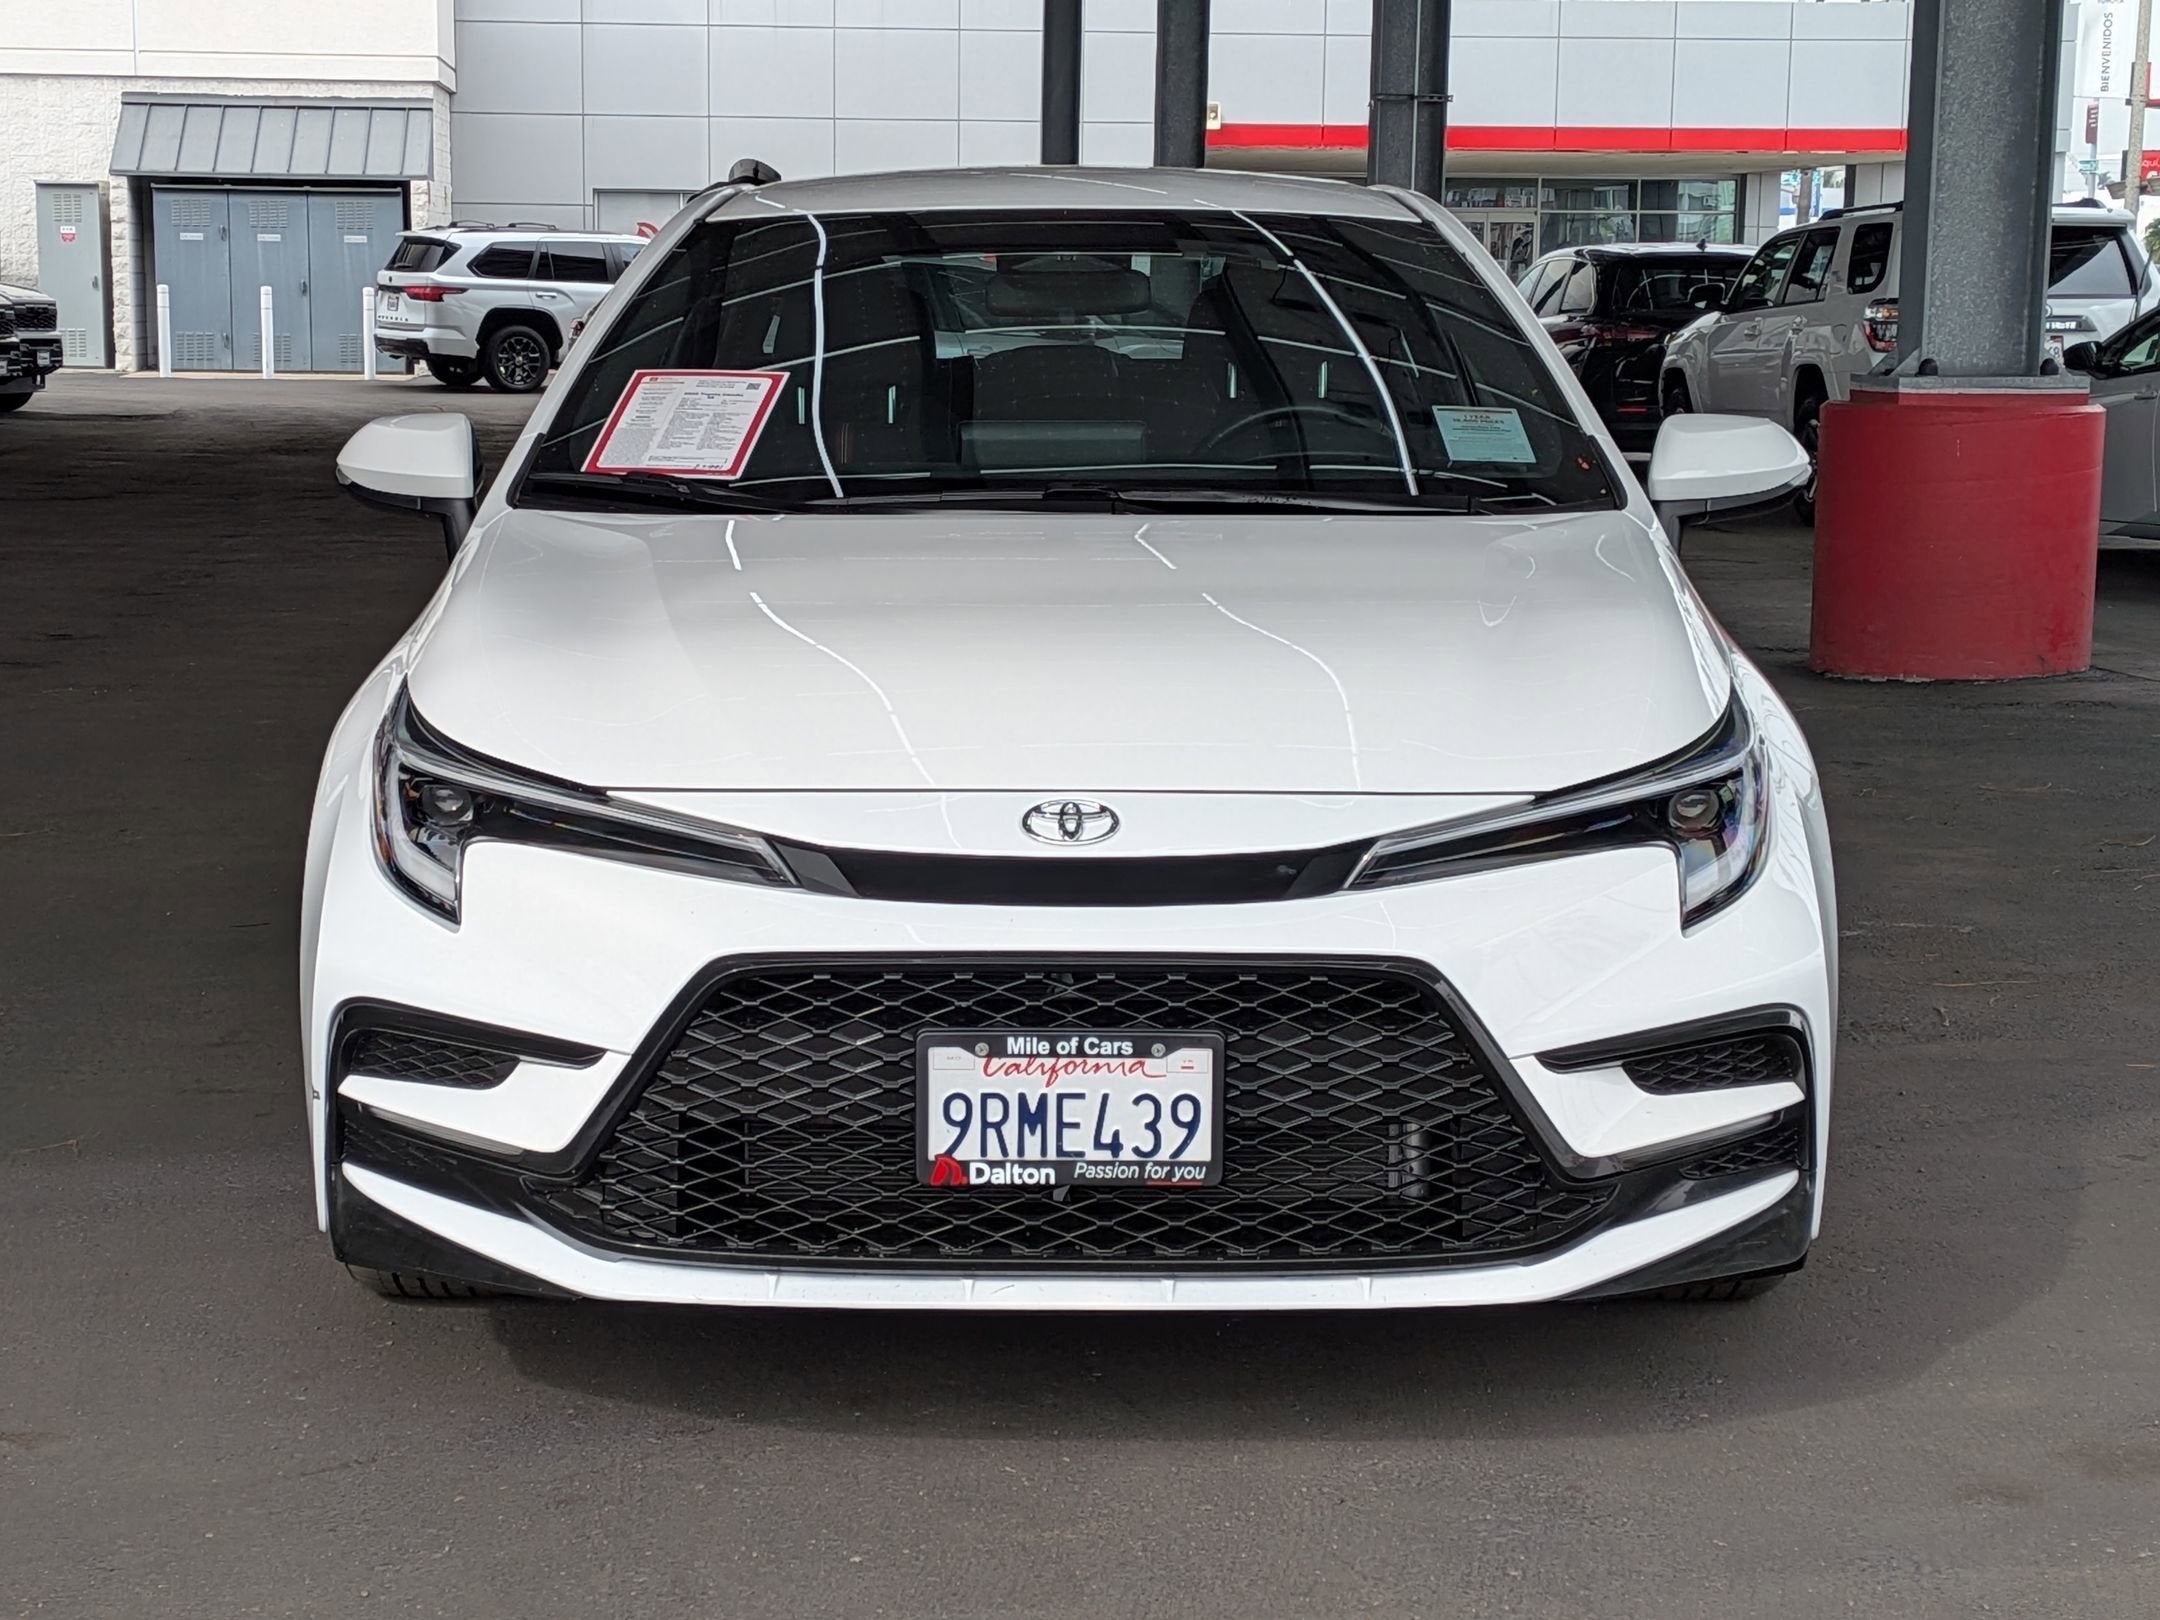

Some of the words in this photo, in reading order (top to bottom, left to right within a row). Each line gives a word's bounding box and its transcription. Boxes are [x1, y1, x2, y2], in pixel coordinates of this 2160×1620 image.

[2100, 12, 2113, 92] BIENVENIDOS
[1006, 1037, 1051, 1055] Mile
[1056, 1037, 1078, 1055] of
[1083, 1037, 1133, 1055] Cars
[983, 1057, 1167, 1088] California
[942, 1091, 1201, 1160] 9RME439
[969, 1162, 1056, 1185] Dalton
[1073, 1162, 1139, 1179] Passion
[1144, 1162, 1170, 1180] for
[1171, 1166, 1207, 1183] you
